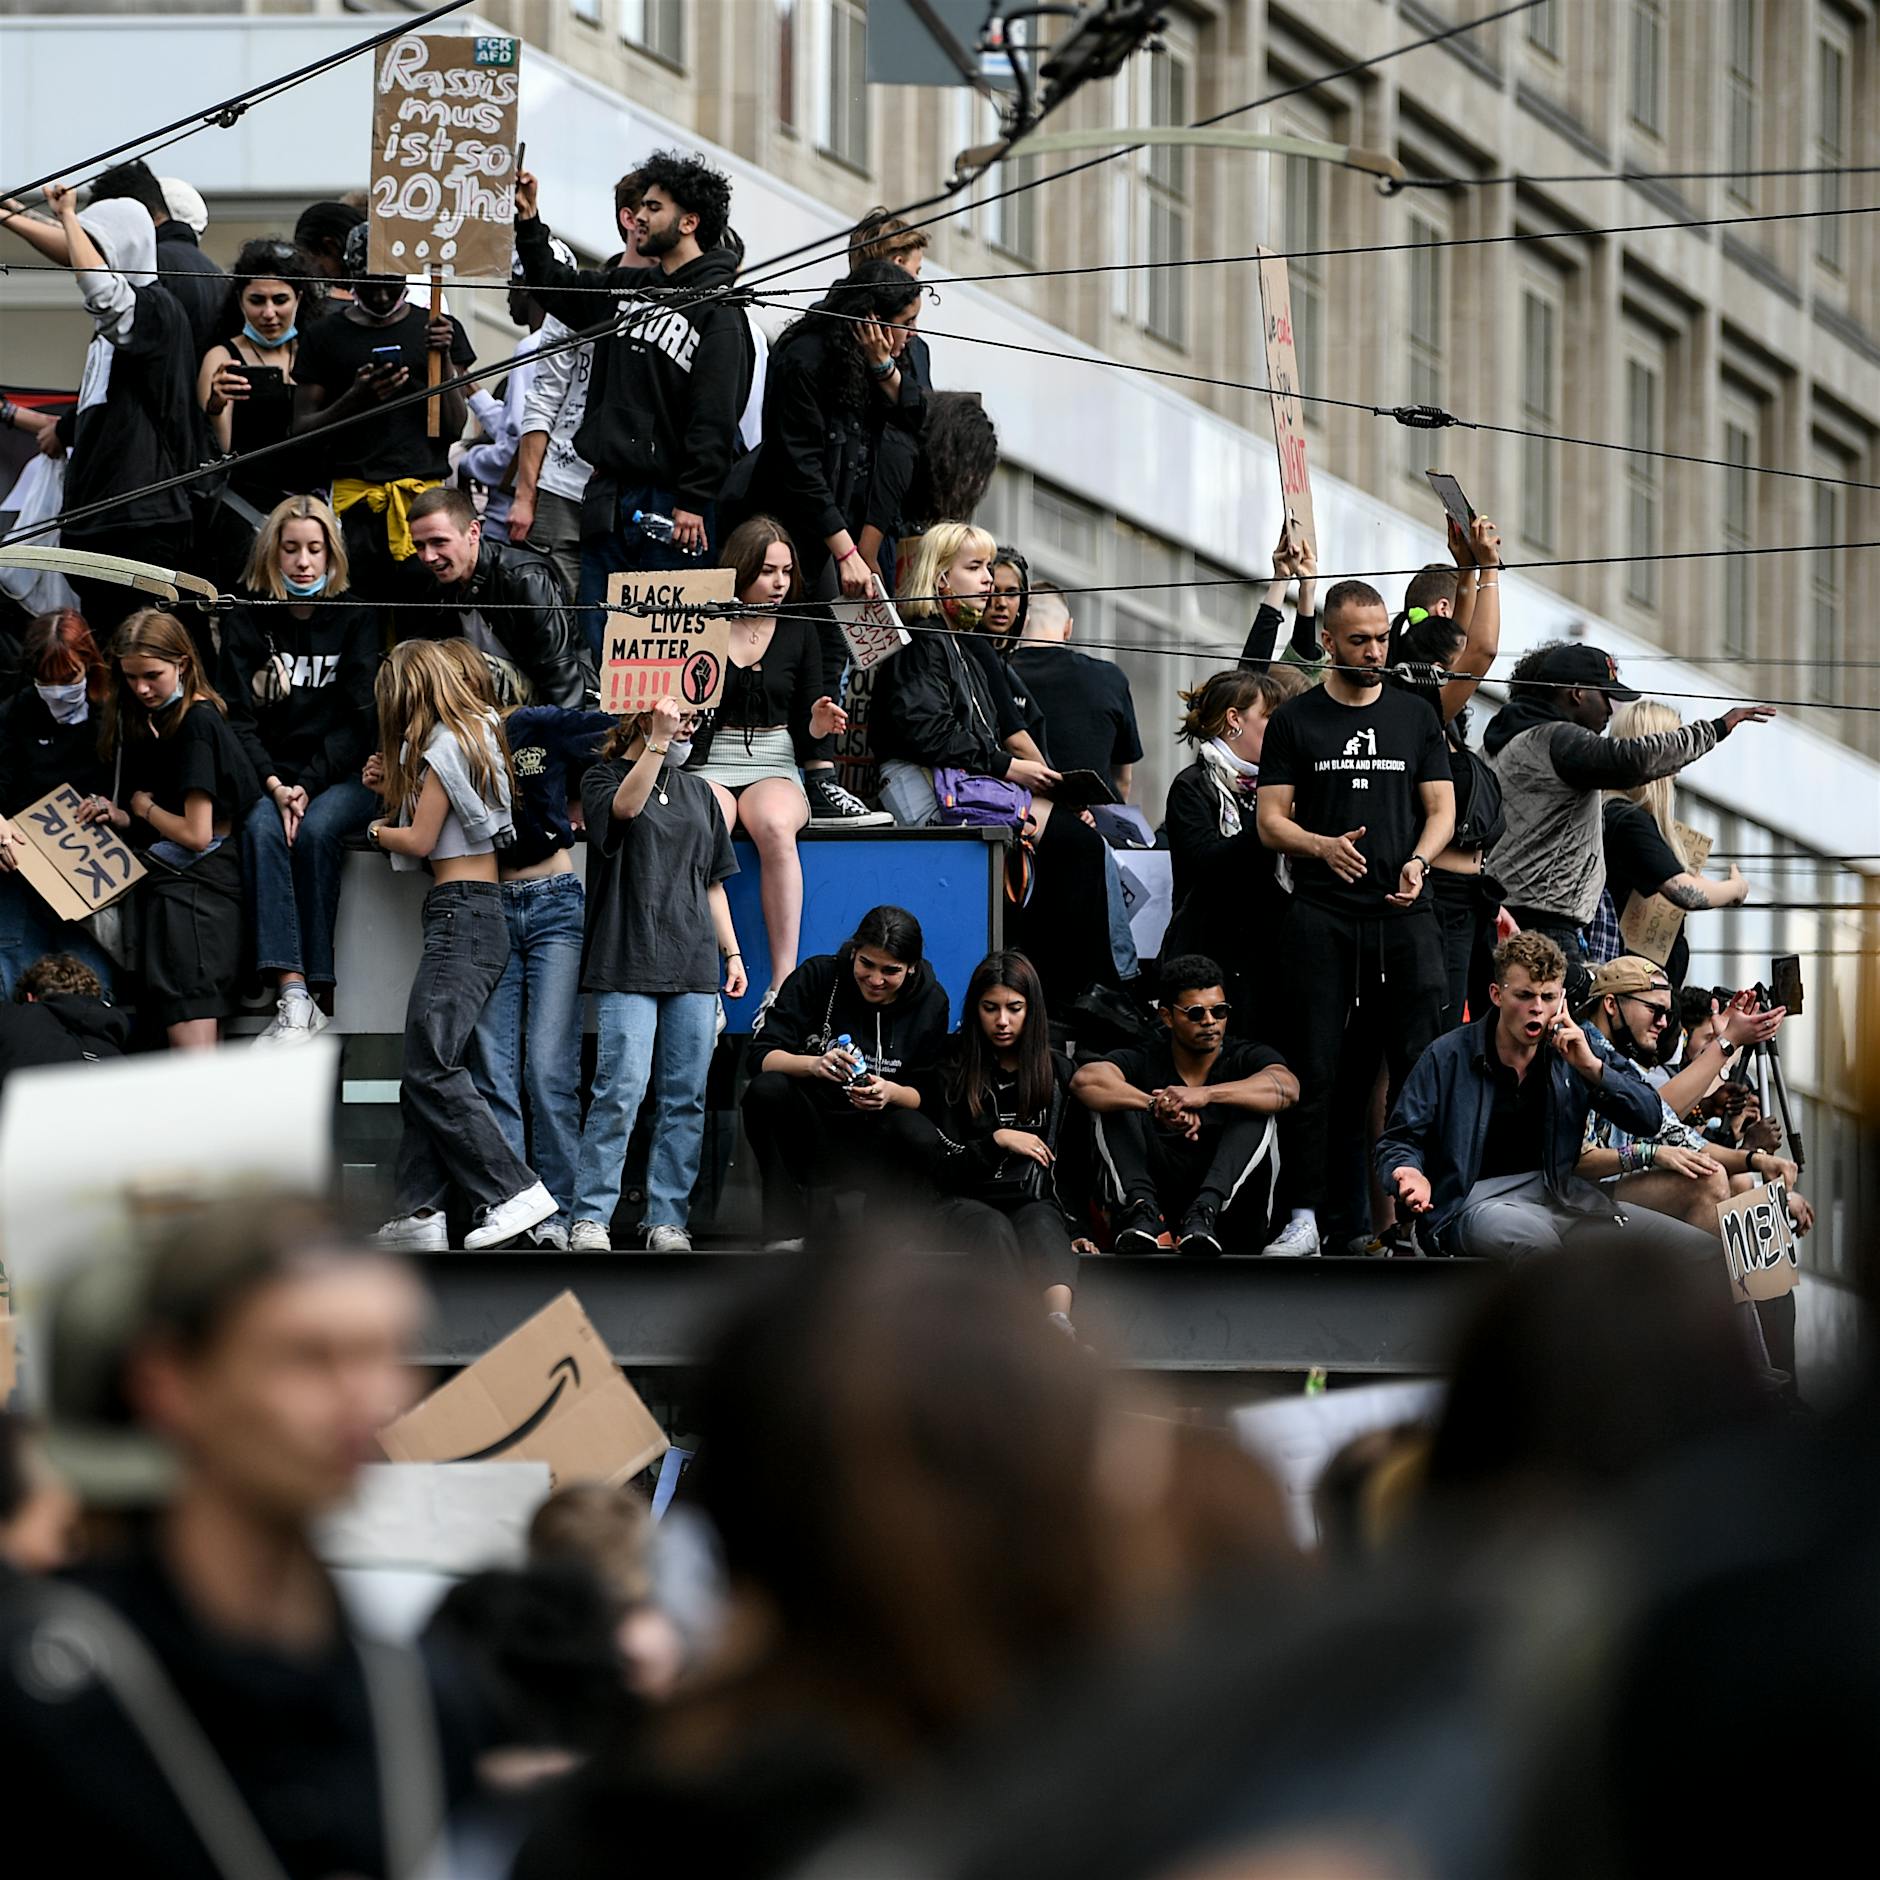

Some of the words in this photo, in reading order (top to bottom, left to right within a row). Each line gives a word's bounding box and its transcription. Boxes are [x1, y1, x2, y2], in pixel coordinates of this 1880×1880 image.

[478, 37, 512, 51] FCK
[477, 50, 512, 63] AFD
[378, 36, 518, 105] Rassis
[398, 97, 504, 134] mus
[384, 122, 453, 171] ist
[451, 140, 512, 176] so
[621, 584, 685, 606] BLACK
[651, 612, 706, 634] LIVES
[612, 638, 689, 660] MATTER
[1314, 761, 1318, 772] I
[1319, 760, 1331, 771] AM
[1331, 759, 1355, 770] BLACK
[1355, 759, 1371, 770] AND
[1372, 759, 1406, 771] PRECIOUS
